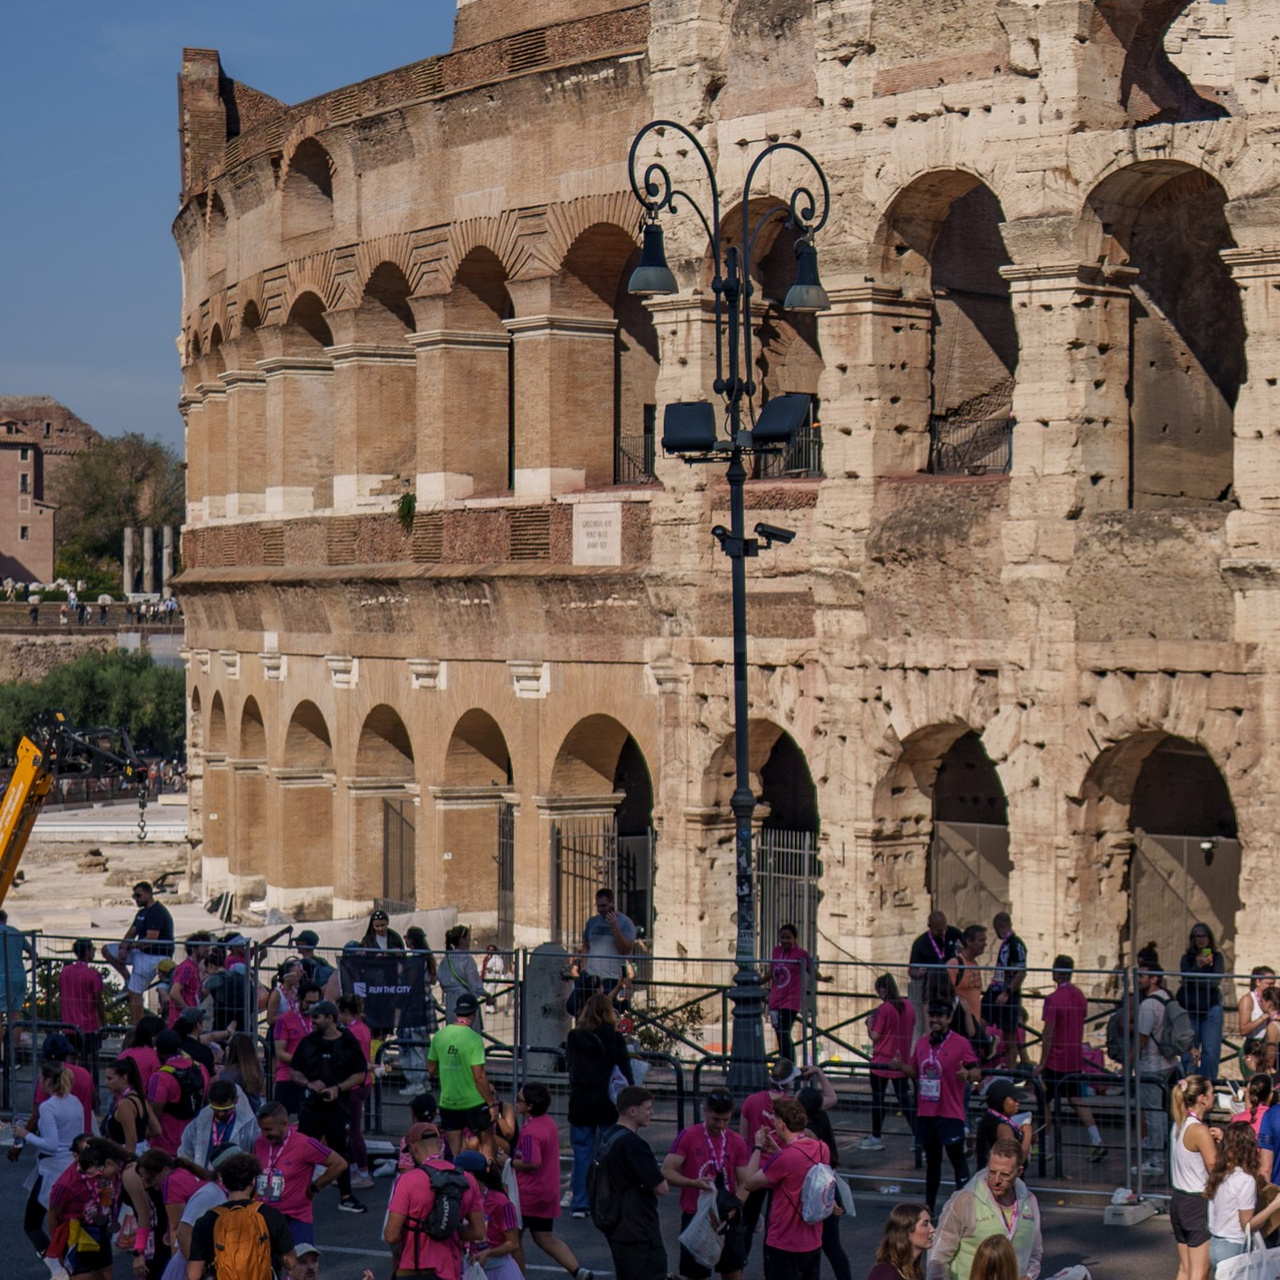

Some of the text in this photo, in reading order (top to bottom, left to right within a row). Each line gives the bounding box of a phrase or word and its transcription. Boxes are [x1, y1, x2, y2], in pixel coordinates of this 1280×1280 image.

[368, 985, 411, 994] RUN THE CITY
